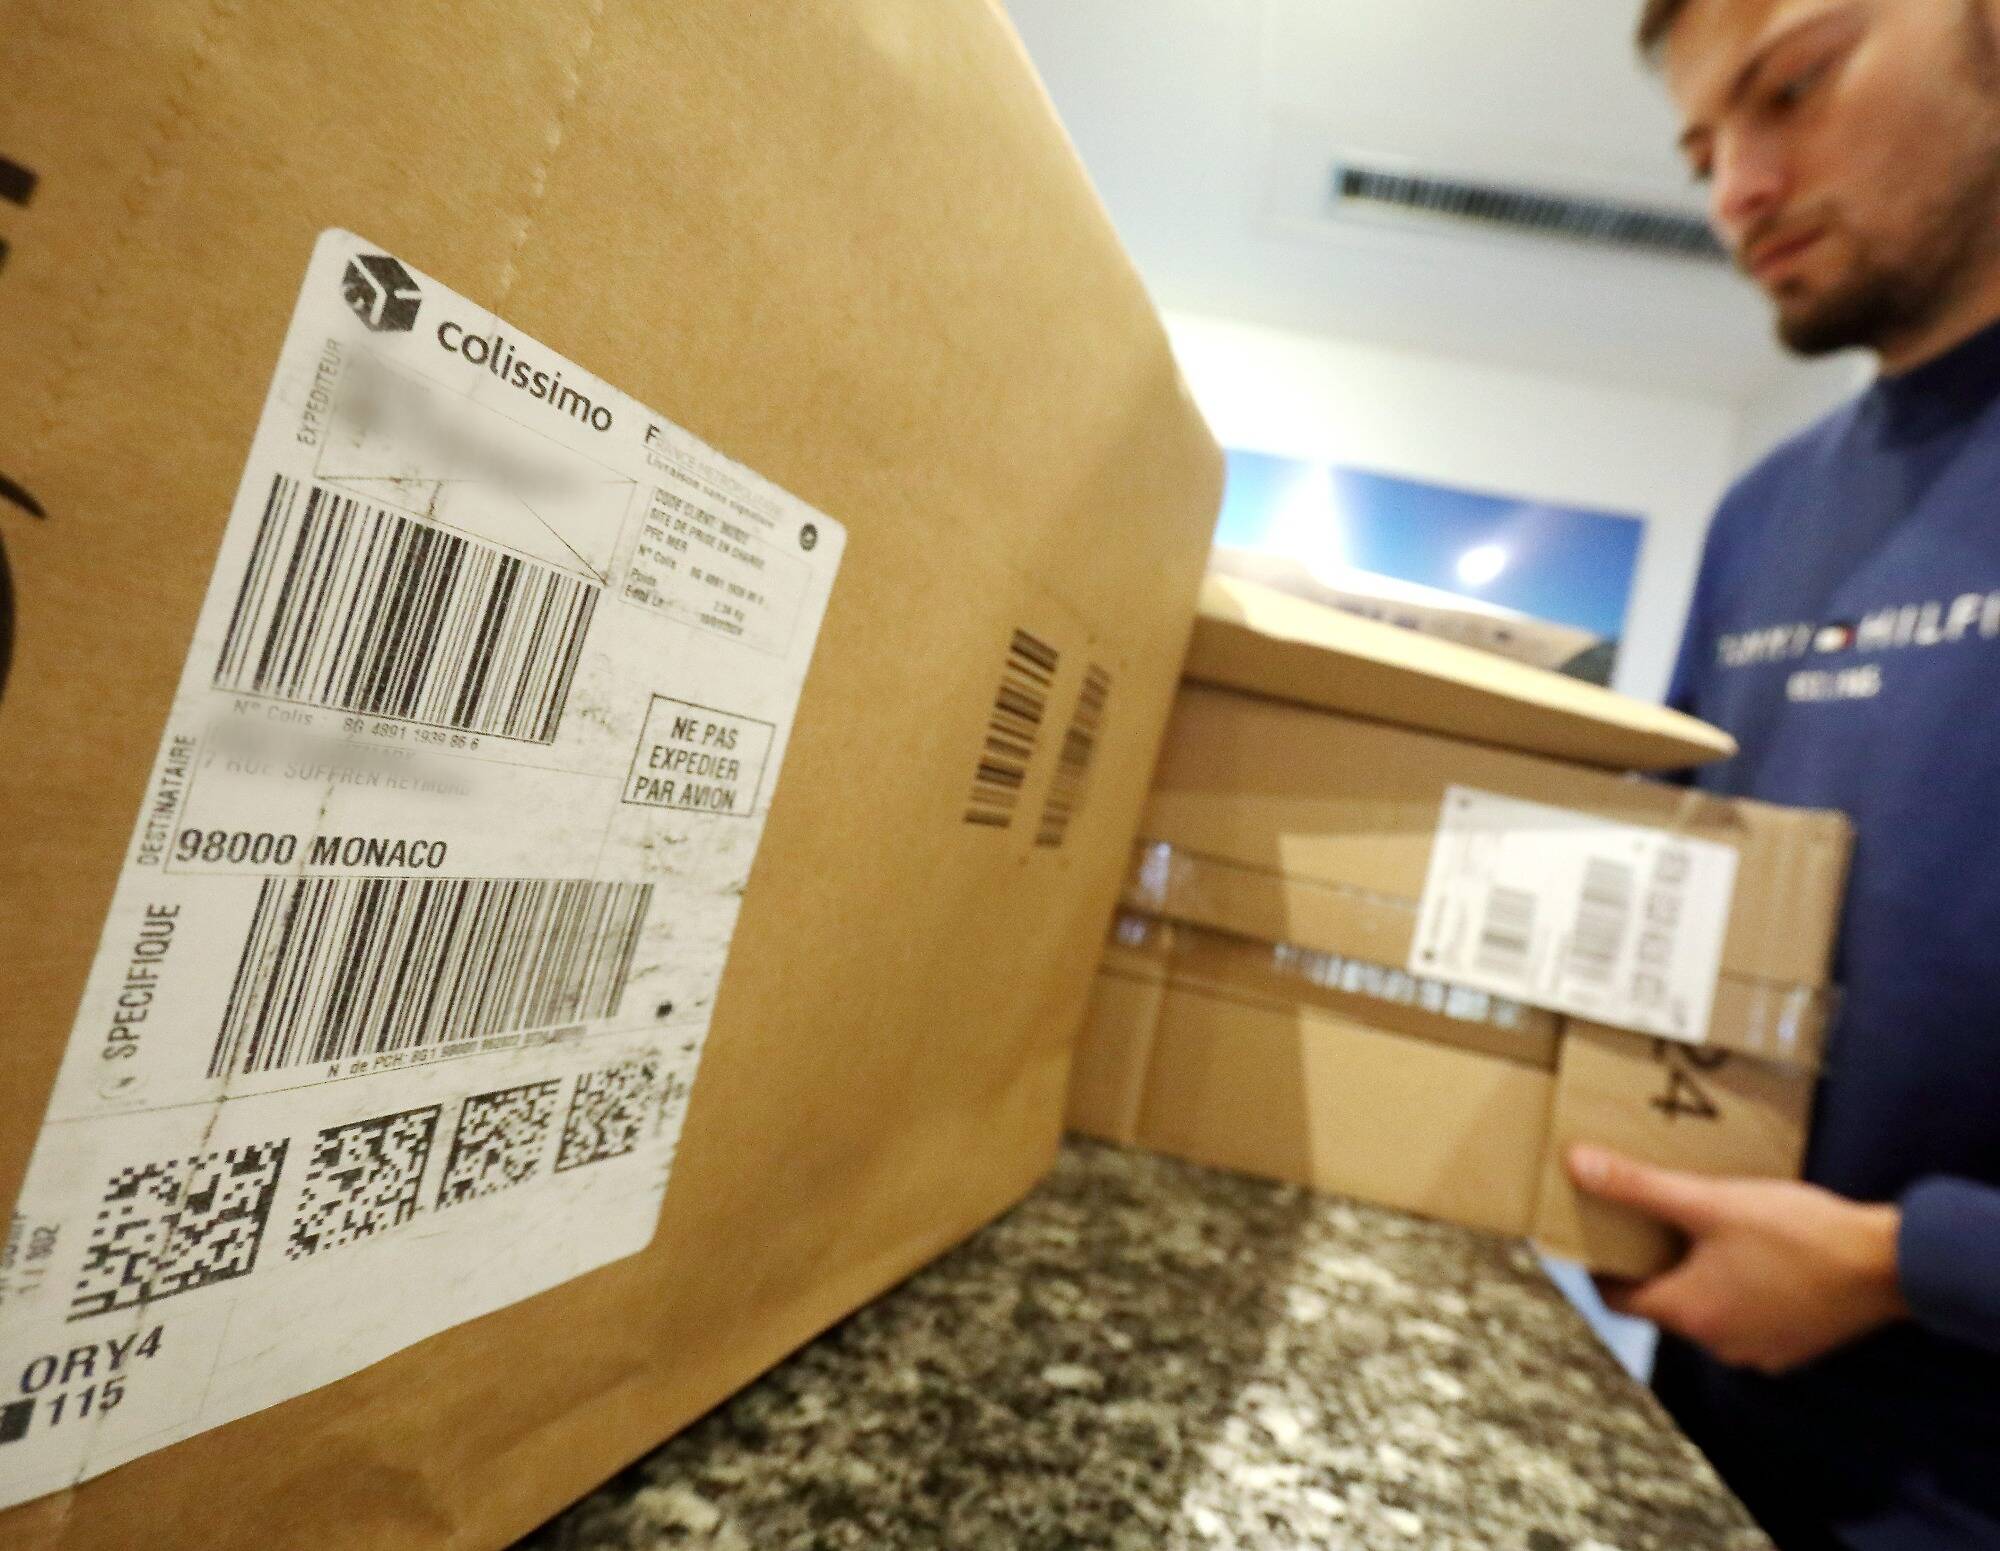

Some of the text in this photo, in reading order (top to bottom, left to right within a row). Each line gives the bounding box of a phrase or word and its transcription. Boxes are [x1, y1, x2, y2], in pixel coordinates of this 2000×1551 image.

[437, 321, 613, 432] colissimo
[267, 705, 313, 726] Colis
[671, 716, 738, 750] NE PAS
[649, 745, 740, 781] EXPEDIER
[137, 734, 196, 867] DESTINATAIRE
[633, 775, 736, 810] PAR AVION
[176, 829, 448, 869] 98000 MONACO
[102, 903, 181, 1060] SPECIFIQUE
[20, 1325, 164, 1395] ORY4
[48, 1375, 128, 1426] 115
